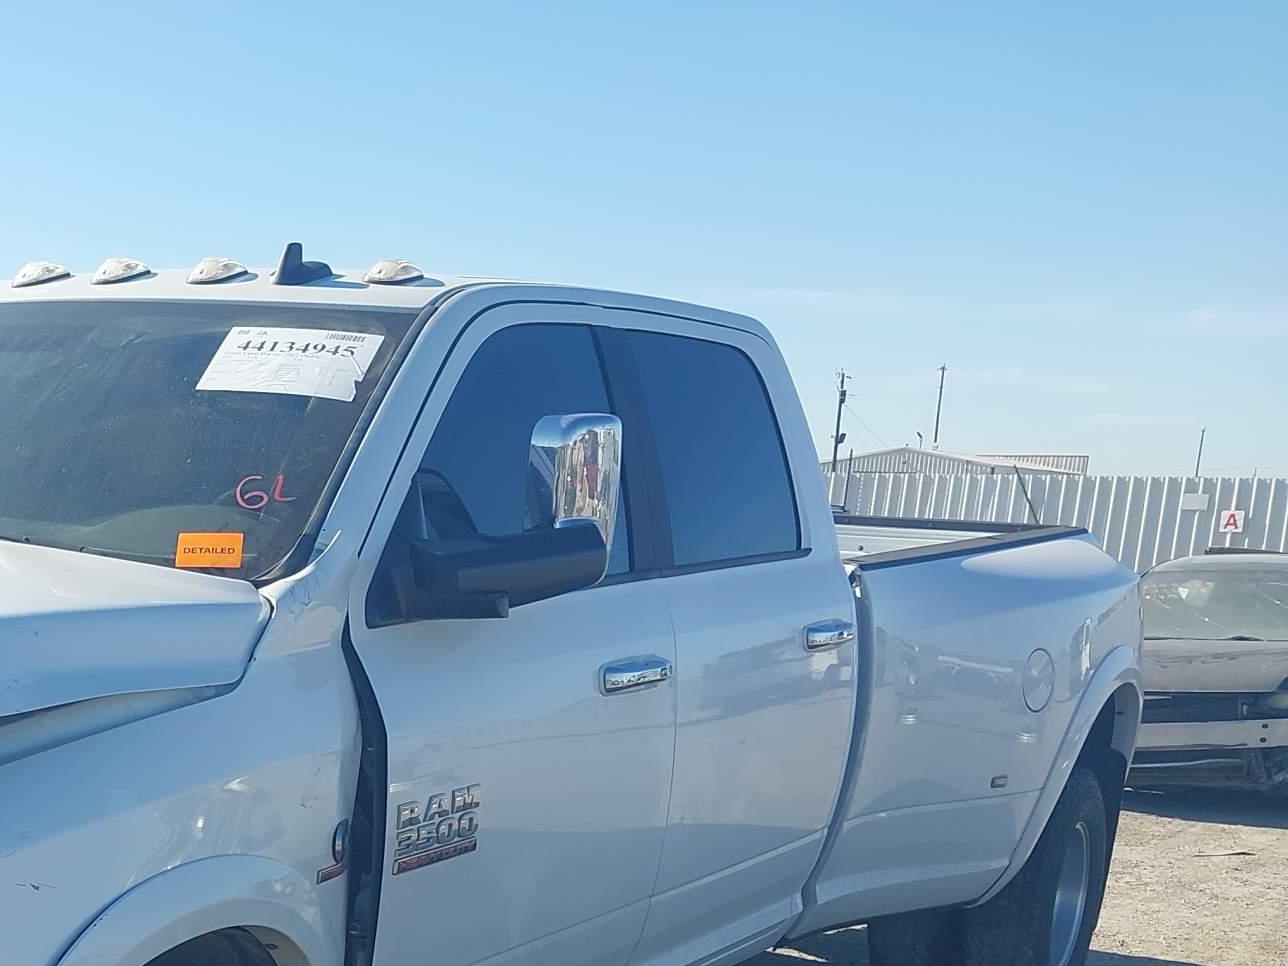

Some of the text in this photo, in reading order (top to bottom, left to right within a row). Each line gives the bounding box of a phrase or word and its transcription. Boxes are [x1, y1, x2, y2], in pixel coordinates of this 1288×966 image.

[237, 339, 358, 357] 44134945
[1223, 513, 1239, 530] A
[397, 783, 480, 830] RAM
